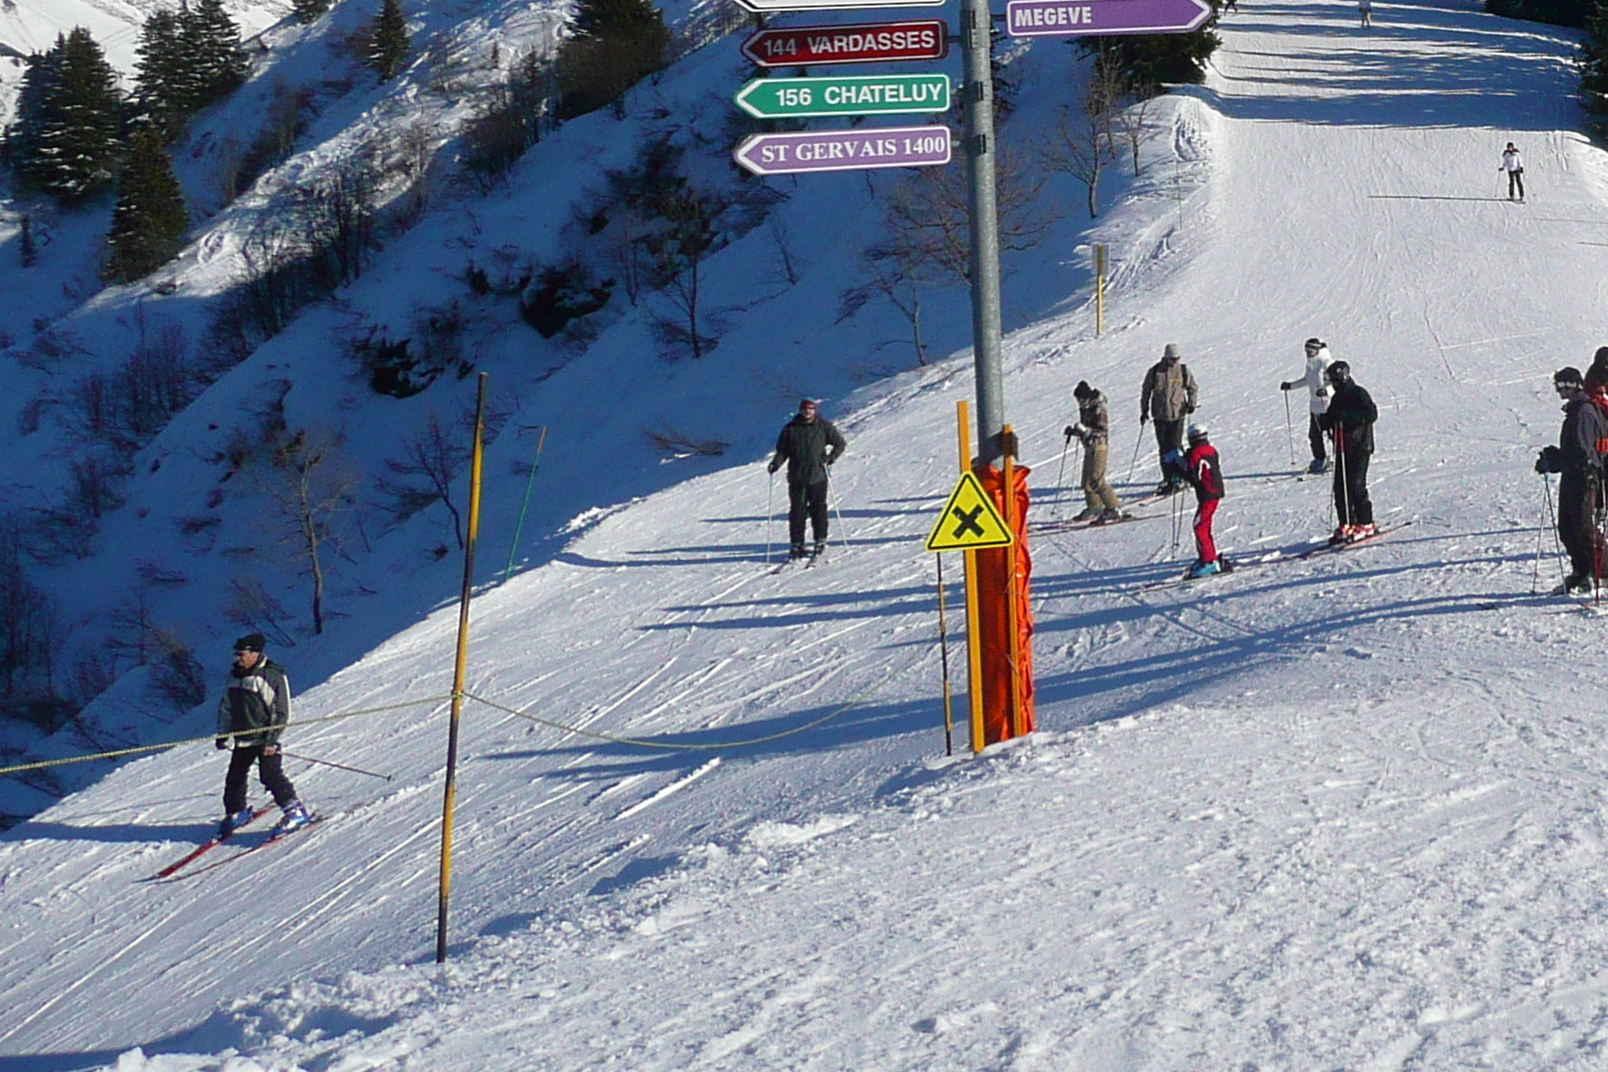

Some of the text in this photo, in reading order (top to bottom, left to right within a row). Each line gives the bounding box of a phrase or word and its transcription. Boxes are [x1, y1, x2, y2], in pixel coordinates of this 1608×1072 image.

[1014, 6, 1092, 27] MEGEVE
[764, 30, 936, 56] 144 VARDASSES
[775, 82, 943, 107] 156 CHATELUY
[761, 136, 945, 163] ST GERVAIS 1400
